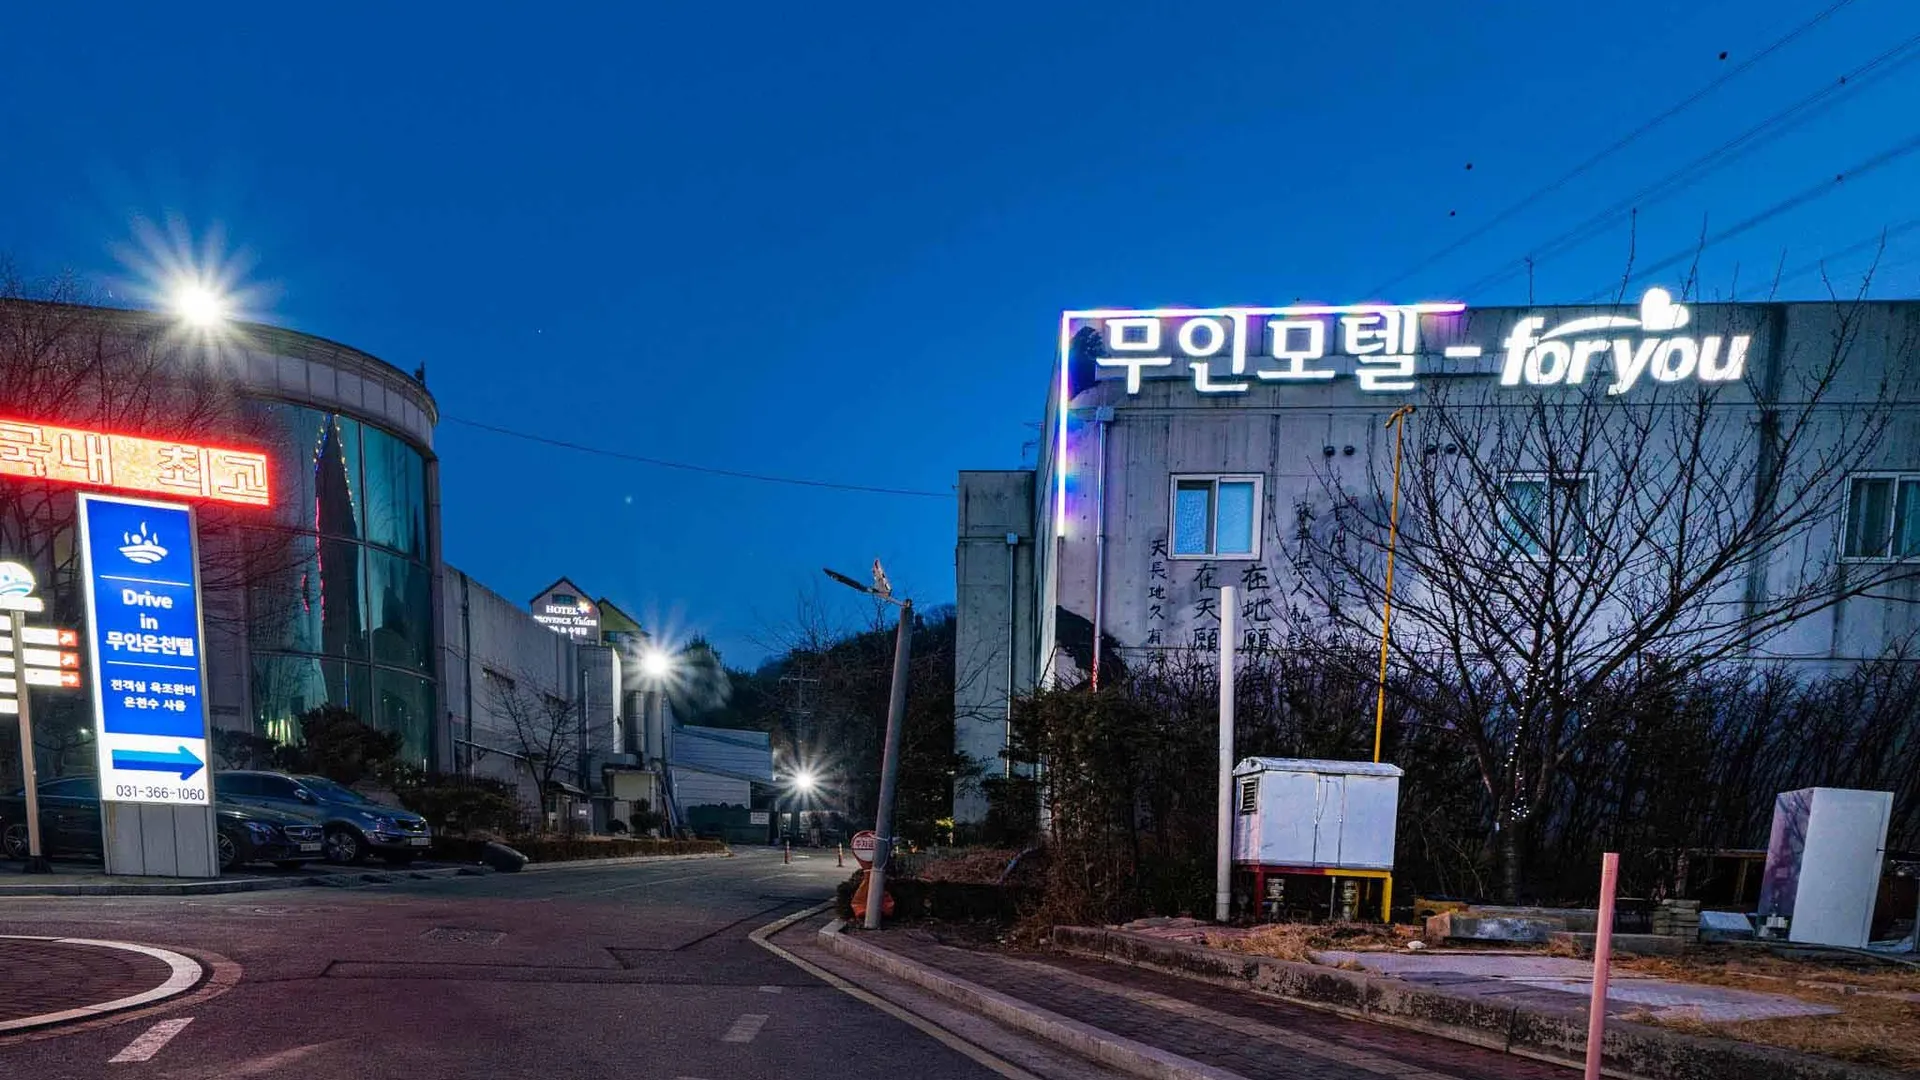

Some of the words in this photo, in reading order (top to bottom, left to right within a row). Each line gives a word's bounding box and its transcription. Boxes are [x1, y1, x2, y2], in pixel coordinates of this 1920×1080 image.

[1096, 307, 1416, 394] 무인모텔
[0, 420, 113, 485] 국내
[157, 444, 270, 502] 최고
[122, 588, 173, 609] Drive
[545, 605, 579, 615] HOTEL
[139, 612, 159, 630] in
[105, 631, 195, 657] 무인온천텔
[149, 681, 196, 697] 욕조완비
[123, 696, 160, 710] 온천수
[162, 699, 187, 712] 사용
[116, 784, 205, 800] 031-366-1060
